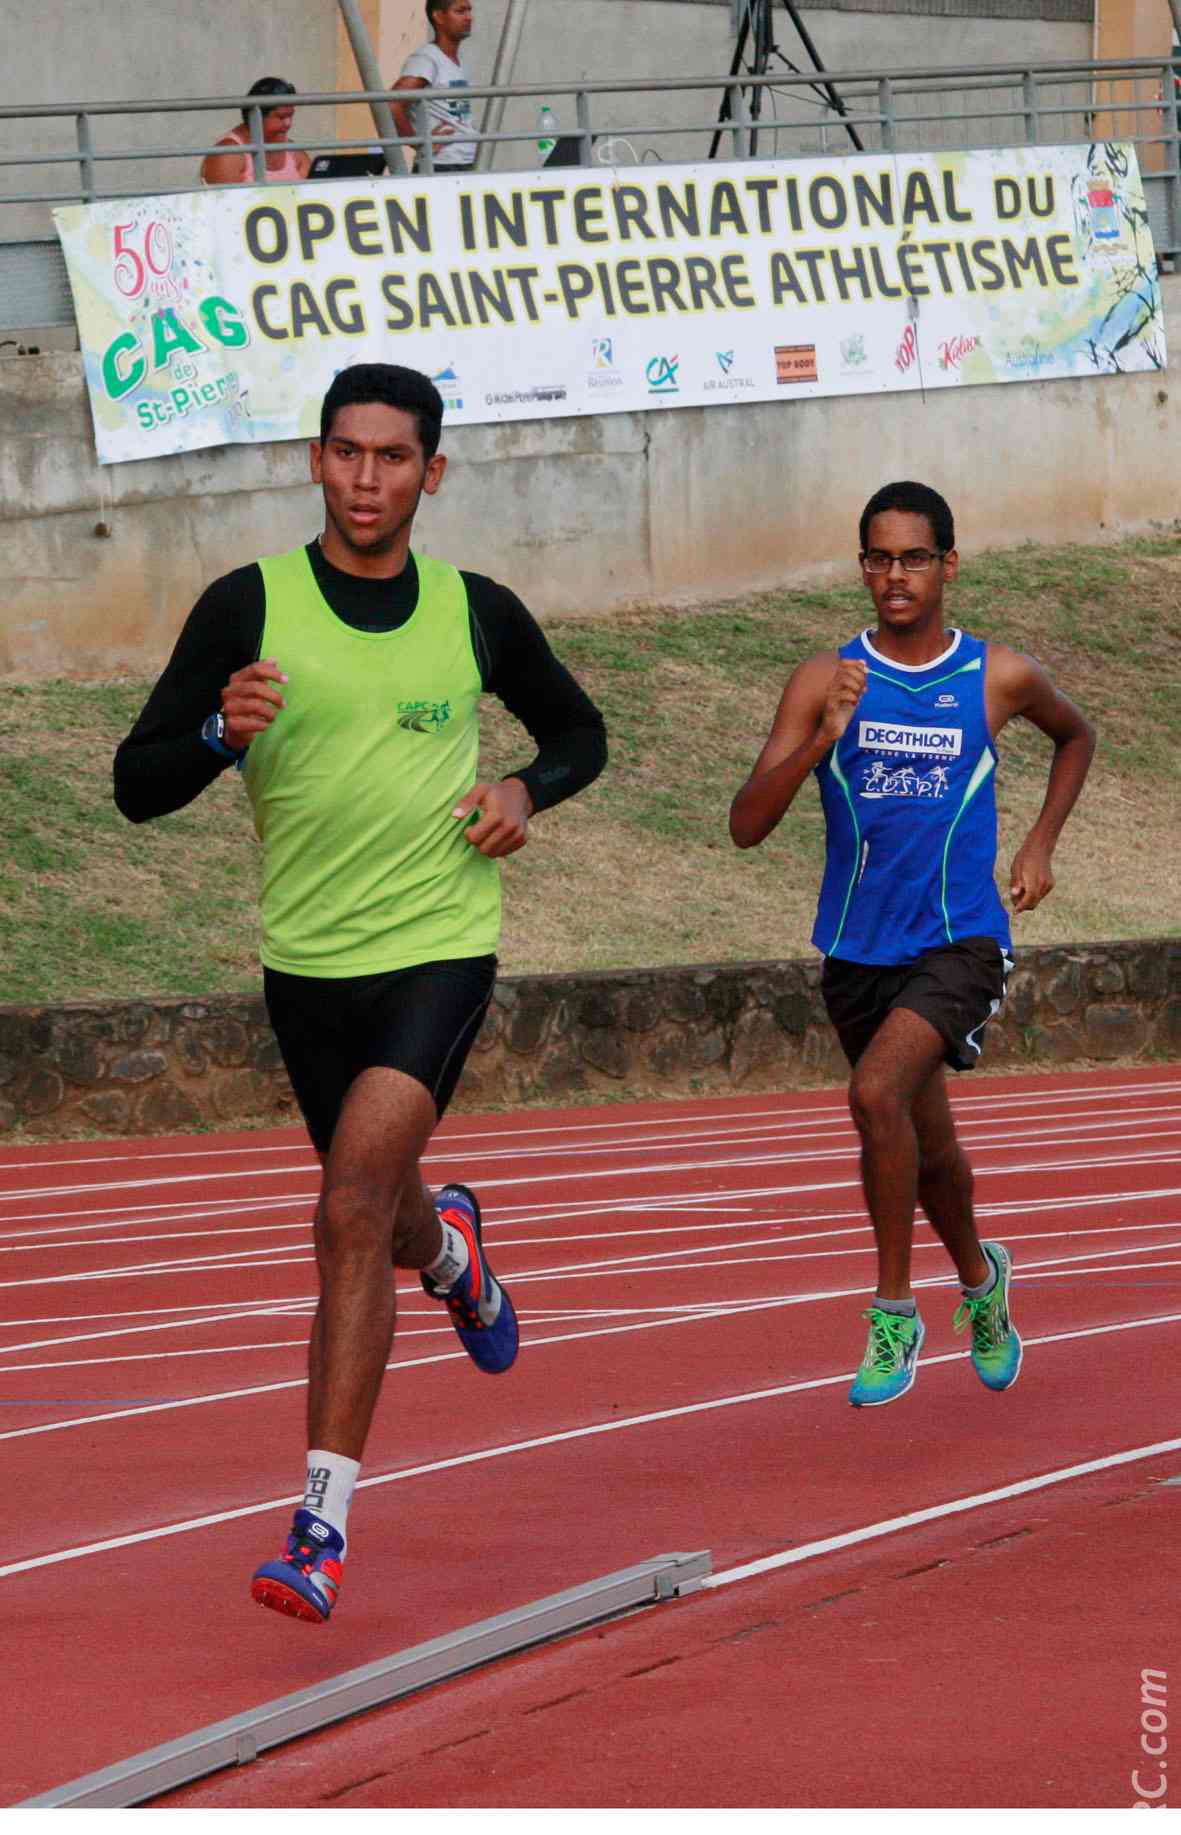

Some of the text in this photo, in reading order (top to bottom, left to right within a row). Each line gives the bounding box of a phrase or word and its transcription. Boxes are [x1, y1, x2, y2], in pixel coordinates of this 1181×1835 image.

[244, 169, 1055, 264] OPEN INTERNATIONAL DU
[113, 221, 173, 297] 50
[252, 230, 1079, 340] CAG SAINT-PIERRE ATHLÉTISME
[102, 295, 249, 400] CAG
[175, 363, 193, 381] de
[865, 727, 955, 749] DECATHLON
[303, 1466, 331, 1514] SPO
